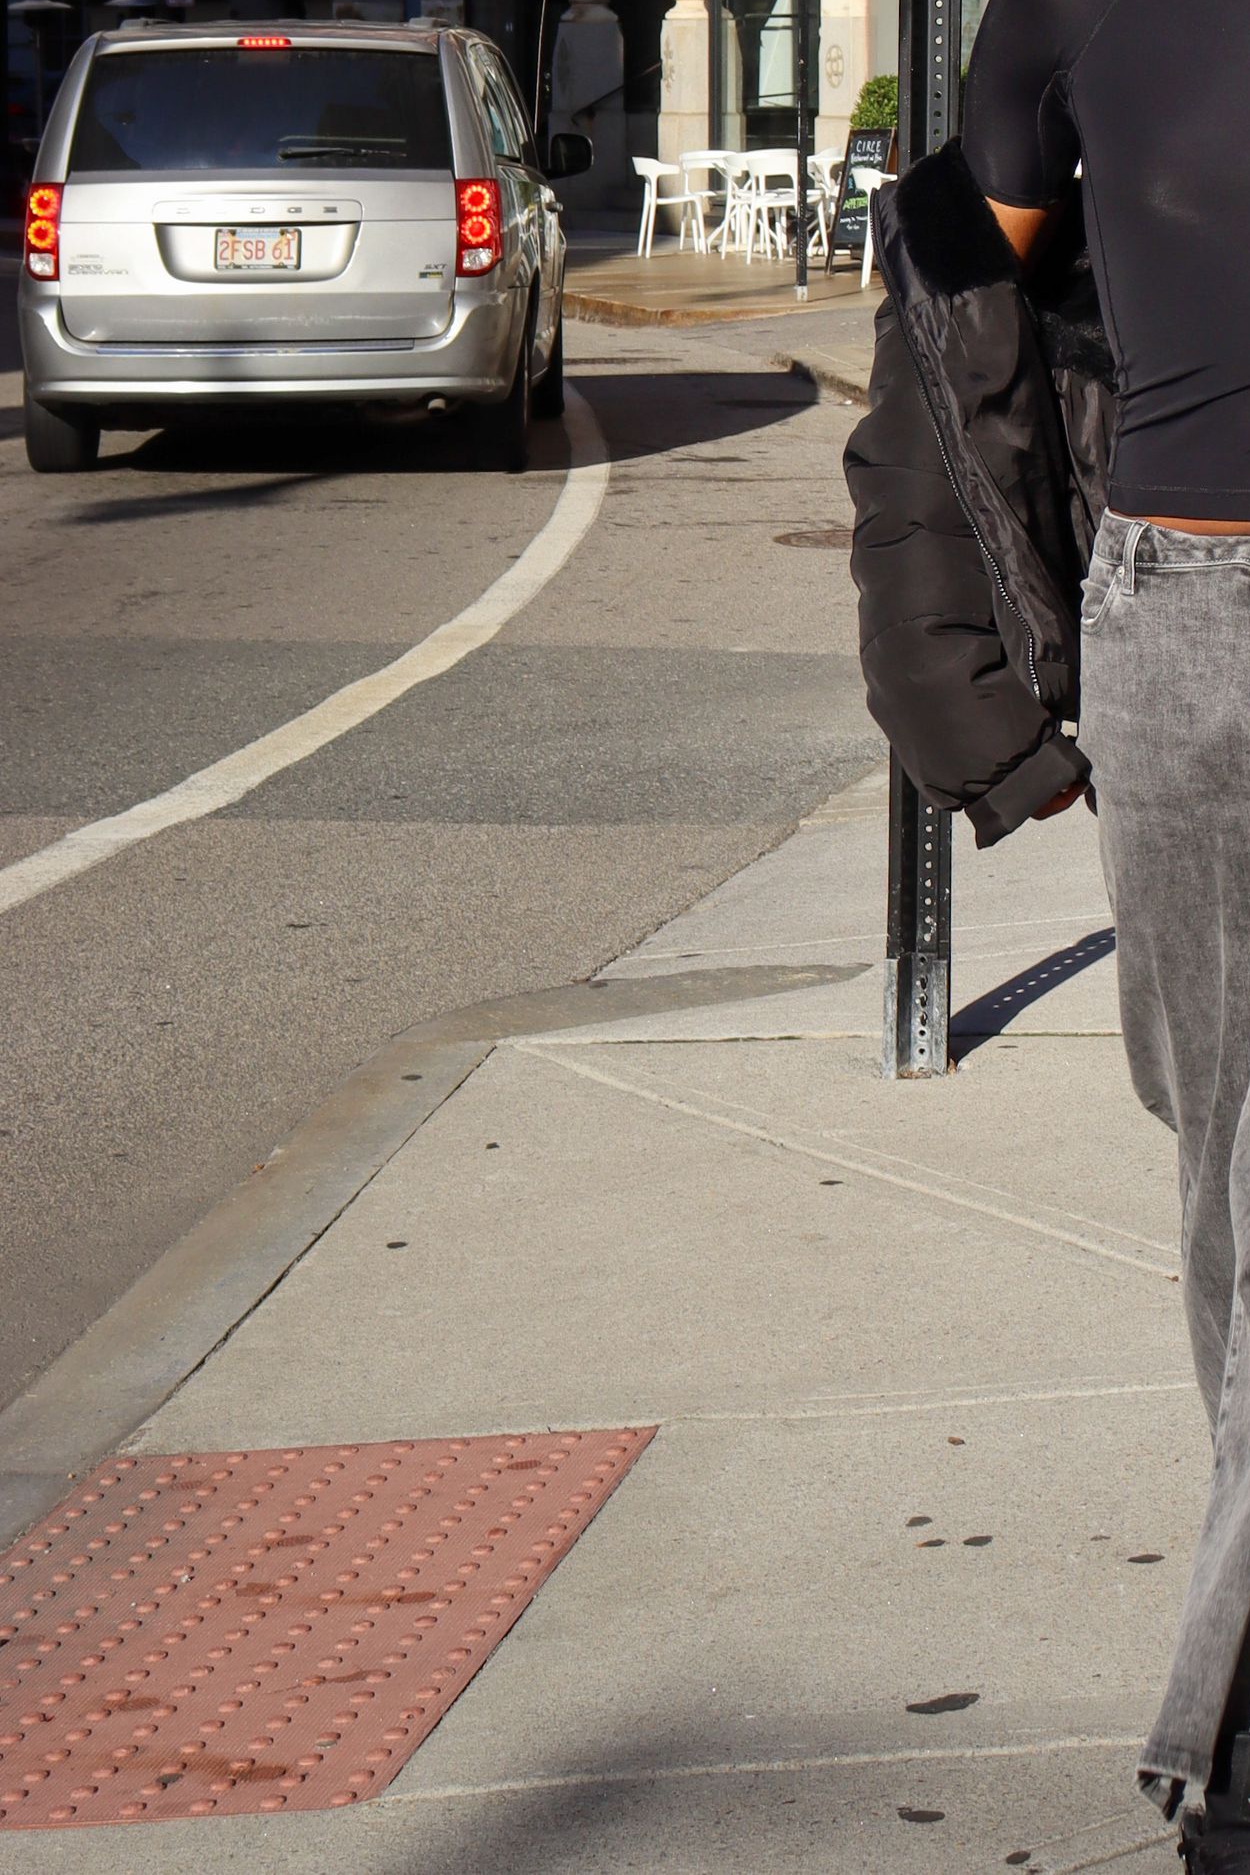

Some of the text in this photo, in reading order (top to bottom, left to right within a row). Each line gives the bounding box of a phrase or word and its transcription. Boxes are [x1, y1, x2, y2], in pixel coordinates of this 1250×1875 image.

[856, 140, 882, 153] CIRCE
[176, 205, 338, 215] DDGE
[219, 239, 294, 261] 2FSB 61
